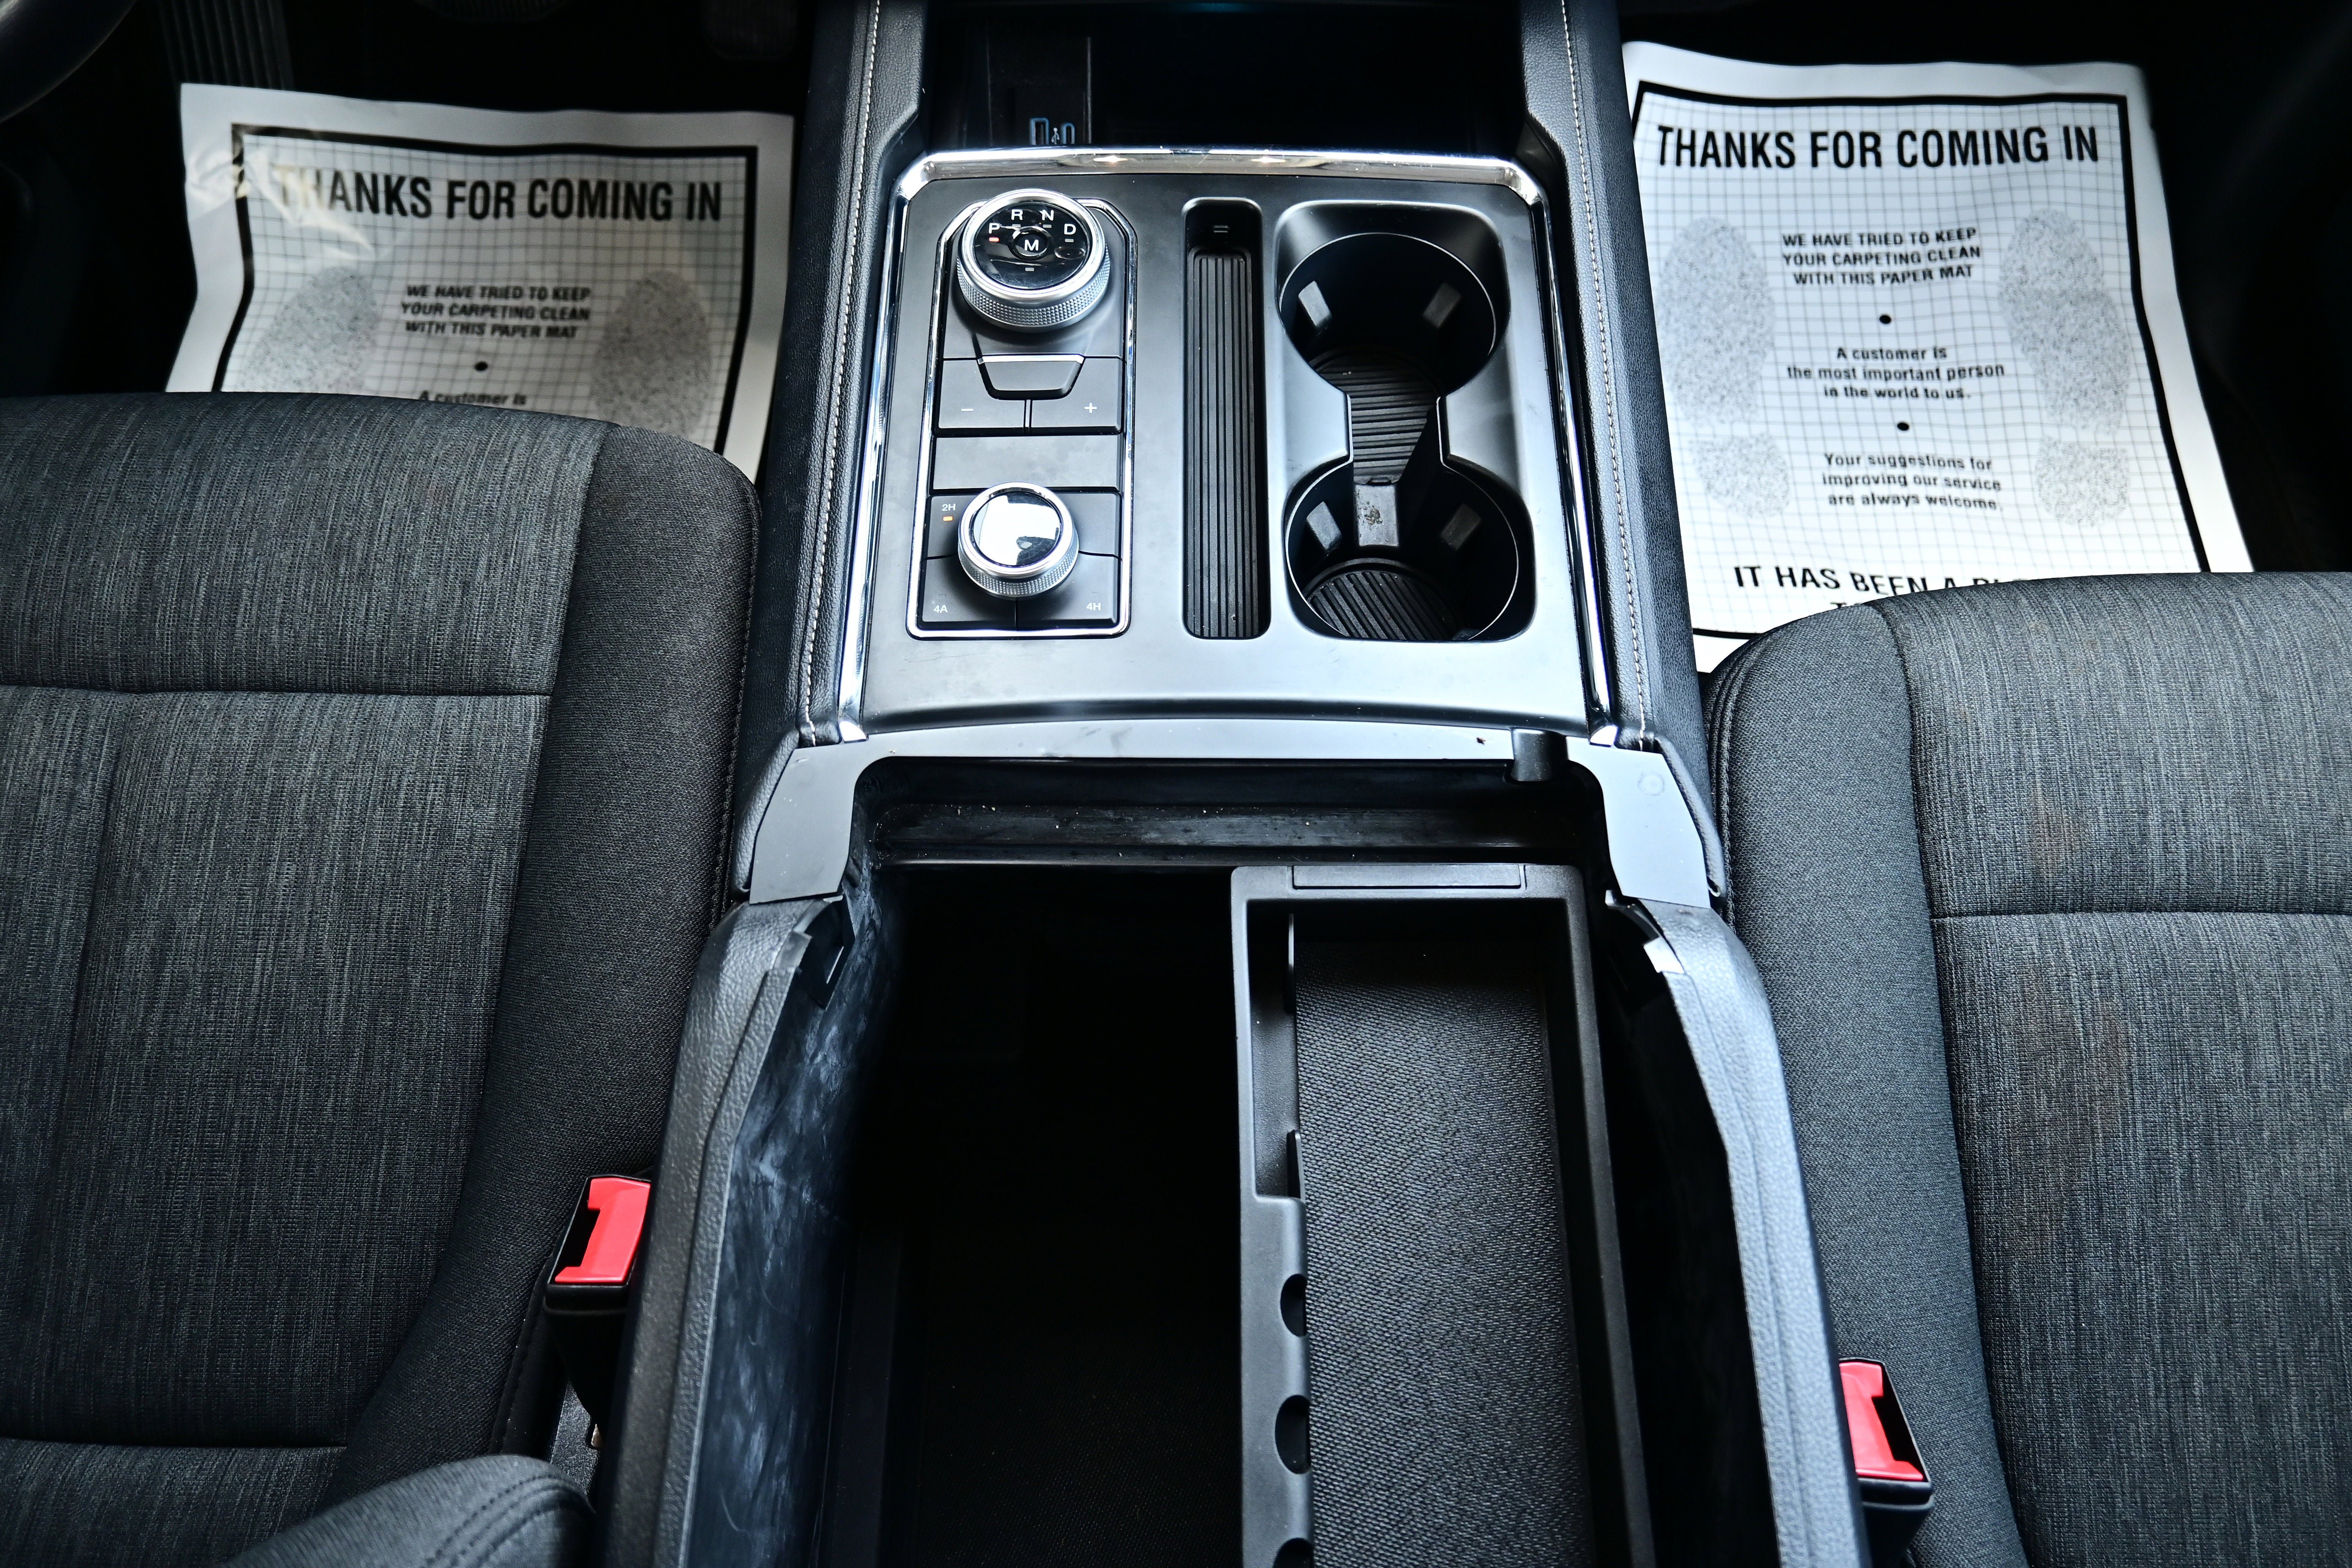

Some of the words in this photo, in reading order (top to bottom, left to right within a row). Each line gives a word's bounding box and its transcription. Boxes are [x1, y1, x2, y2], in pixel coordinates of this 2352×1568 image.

[1658, 125, 1795, 168] THANKS
[1811, 131, 1882, 168] FOR
[1897, 127, 2048, 168] COMING
[2065, 125, 2098, 162] IN
[446, 180, 515, 220] FOR
[528, 178, 672, 221] COMING
[686, 182, 721, 220] IN
[1011, 210, 1023, 220] R
[1042, 210, 1054, 220] N
[989, 223, 1000, 234] P
[1064, 224, 1076, 235] D
[1783, 234, 1805, 246] WE
[1813, 233, 1852, 246] HAVE
[1859, 232, 1903, 245] TRIED
[1911, 231, 1929, 245] TO
[1936, 227, 1976, 242] KEEP
[1024, 240, 1039, 250] M
[1783, 253, 1826, 266] YOUR
[1833, 252, 1921, 265] CARPETING
[1927, 246, 1980, 262] CLEAN
[1794, 272, 1834, 285] WITH
[1842, 272, 1875, 284] THIS
[1881, 269, 1933, 284] PAPER
[1940, 264, 1973, 279] MAT
[406, 285, 429, 297] WE
[435, 286, 474, 298] HAVE
[480, 286, 523, 299] TRIED
[529, 287, 548, 300] TO
[552, 287, 591, 301] KEEP
[401, 302, 443, 315] YOUR
[449, 303, 535, 319] CARPETING
[540, 307, 590, 321] CLEAN
[406, 321, 446, 334] WITH
[452, 322, 485, 335] THIS
[490, 324, 540, 337] PAPER
[546, 326, 577, 338] MAT
[1836, 348, 1847, 359] A
[1853, 348, 1926, 360] customer
[1933, 346, 1947, 359] is
[1787, 365, 1813, 379] the
[1818, 368, 1857, 380] most
[1862, 365, 1941, 382] important
[1946, 364, 2004, 381] person
[419, 390, 429, 401] A
[513, 394, 526, 405] is
[1824, 387, 1839, 397] in
[1844, 386, 1868, 398] the
[1875, 387, 1919, 398] world
[1924, 387, 1939, 399] to
[1825, 452, 1861, 466] Your
[1868, 454, 1965, 469] suggestions
[1970, 456, 1992, 471] for
[1822, 472, 1908, 488] improving
[1913, 474, 1938, 486] our
[1944, 476, 2001, 491] service
[1829, 494, 1854, 506] are
[1862, 492, 1920, 507] always
[942, 504, 956, 512] 2H
[1734, 566, 1761, 587] IT
[1775, 566, 1840, 589] HAS
[1850, 571, 1928, 596] BEEN
[934, 604, 948, 613] 4A
[1086, 603, 1101, 611] 4H
